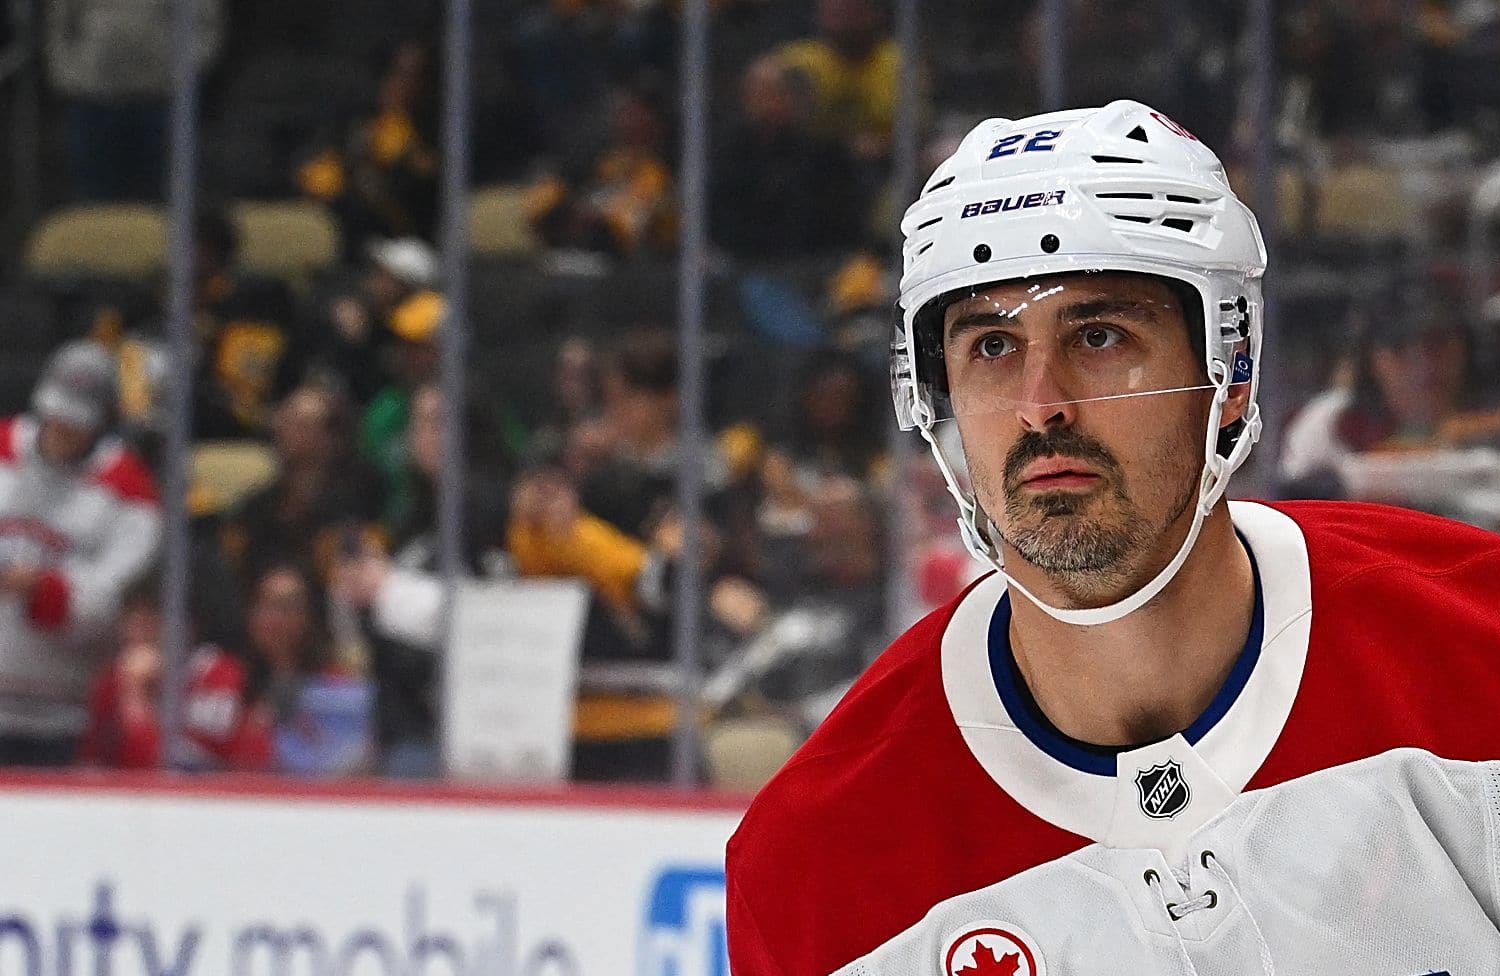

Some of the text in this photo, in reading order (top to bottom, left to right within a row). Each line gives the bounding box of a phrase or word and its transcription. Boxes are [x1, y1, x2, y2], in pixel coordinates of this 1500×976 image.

[985, 128, 1064, 162] 22
[960, 189, 1067, 220] BAUER
[1150, 773, 1177, 812] NHL
